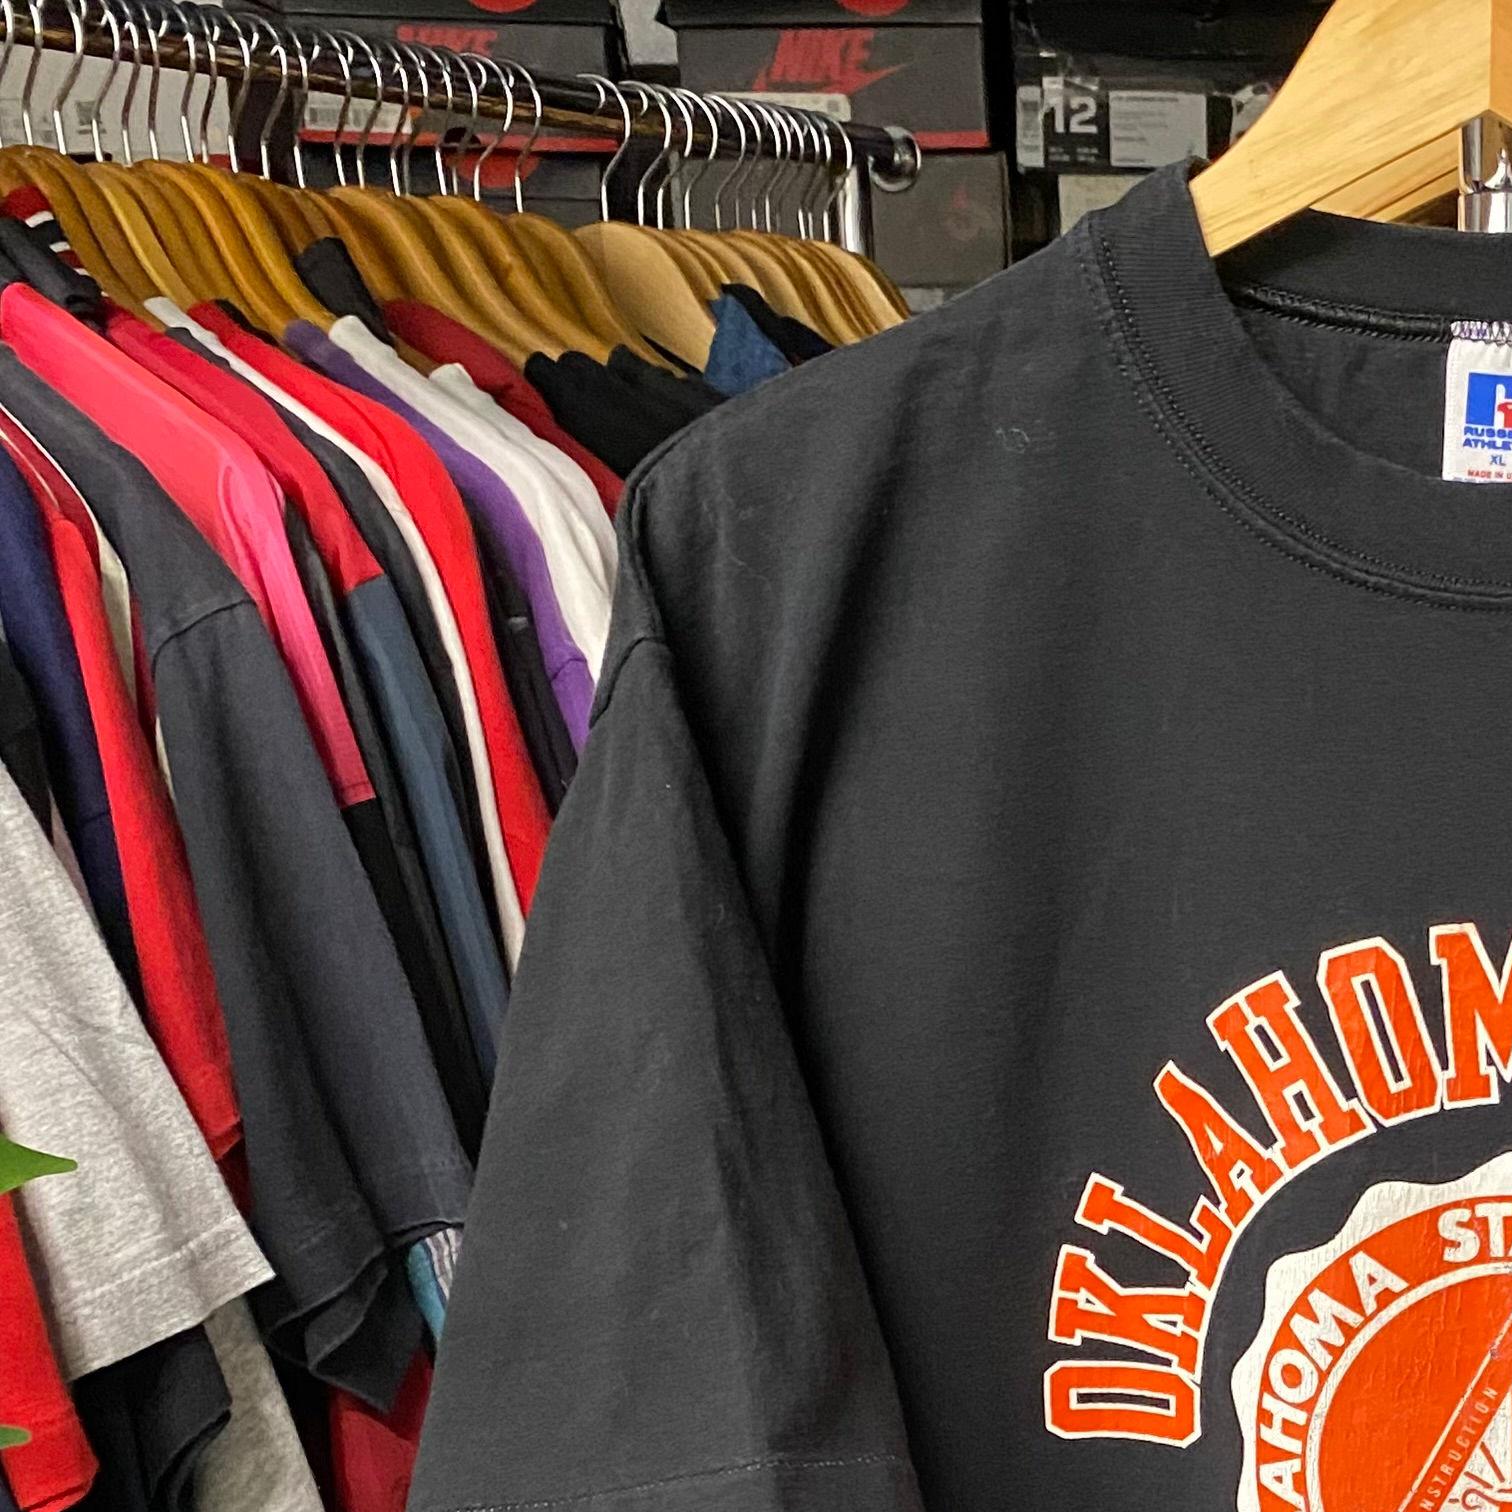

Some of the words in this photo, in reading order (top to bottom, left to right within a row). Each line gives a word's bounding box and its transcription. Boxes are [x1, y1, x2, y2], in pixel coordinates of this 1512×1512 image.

[1046, 97, 1098, 133] 12
[1490, 454, 1506, 466] XL
[1467, 469, 1492, 479] MADE
